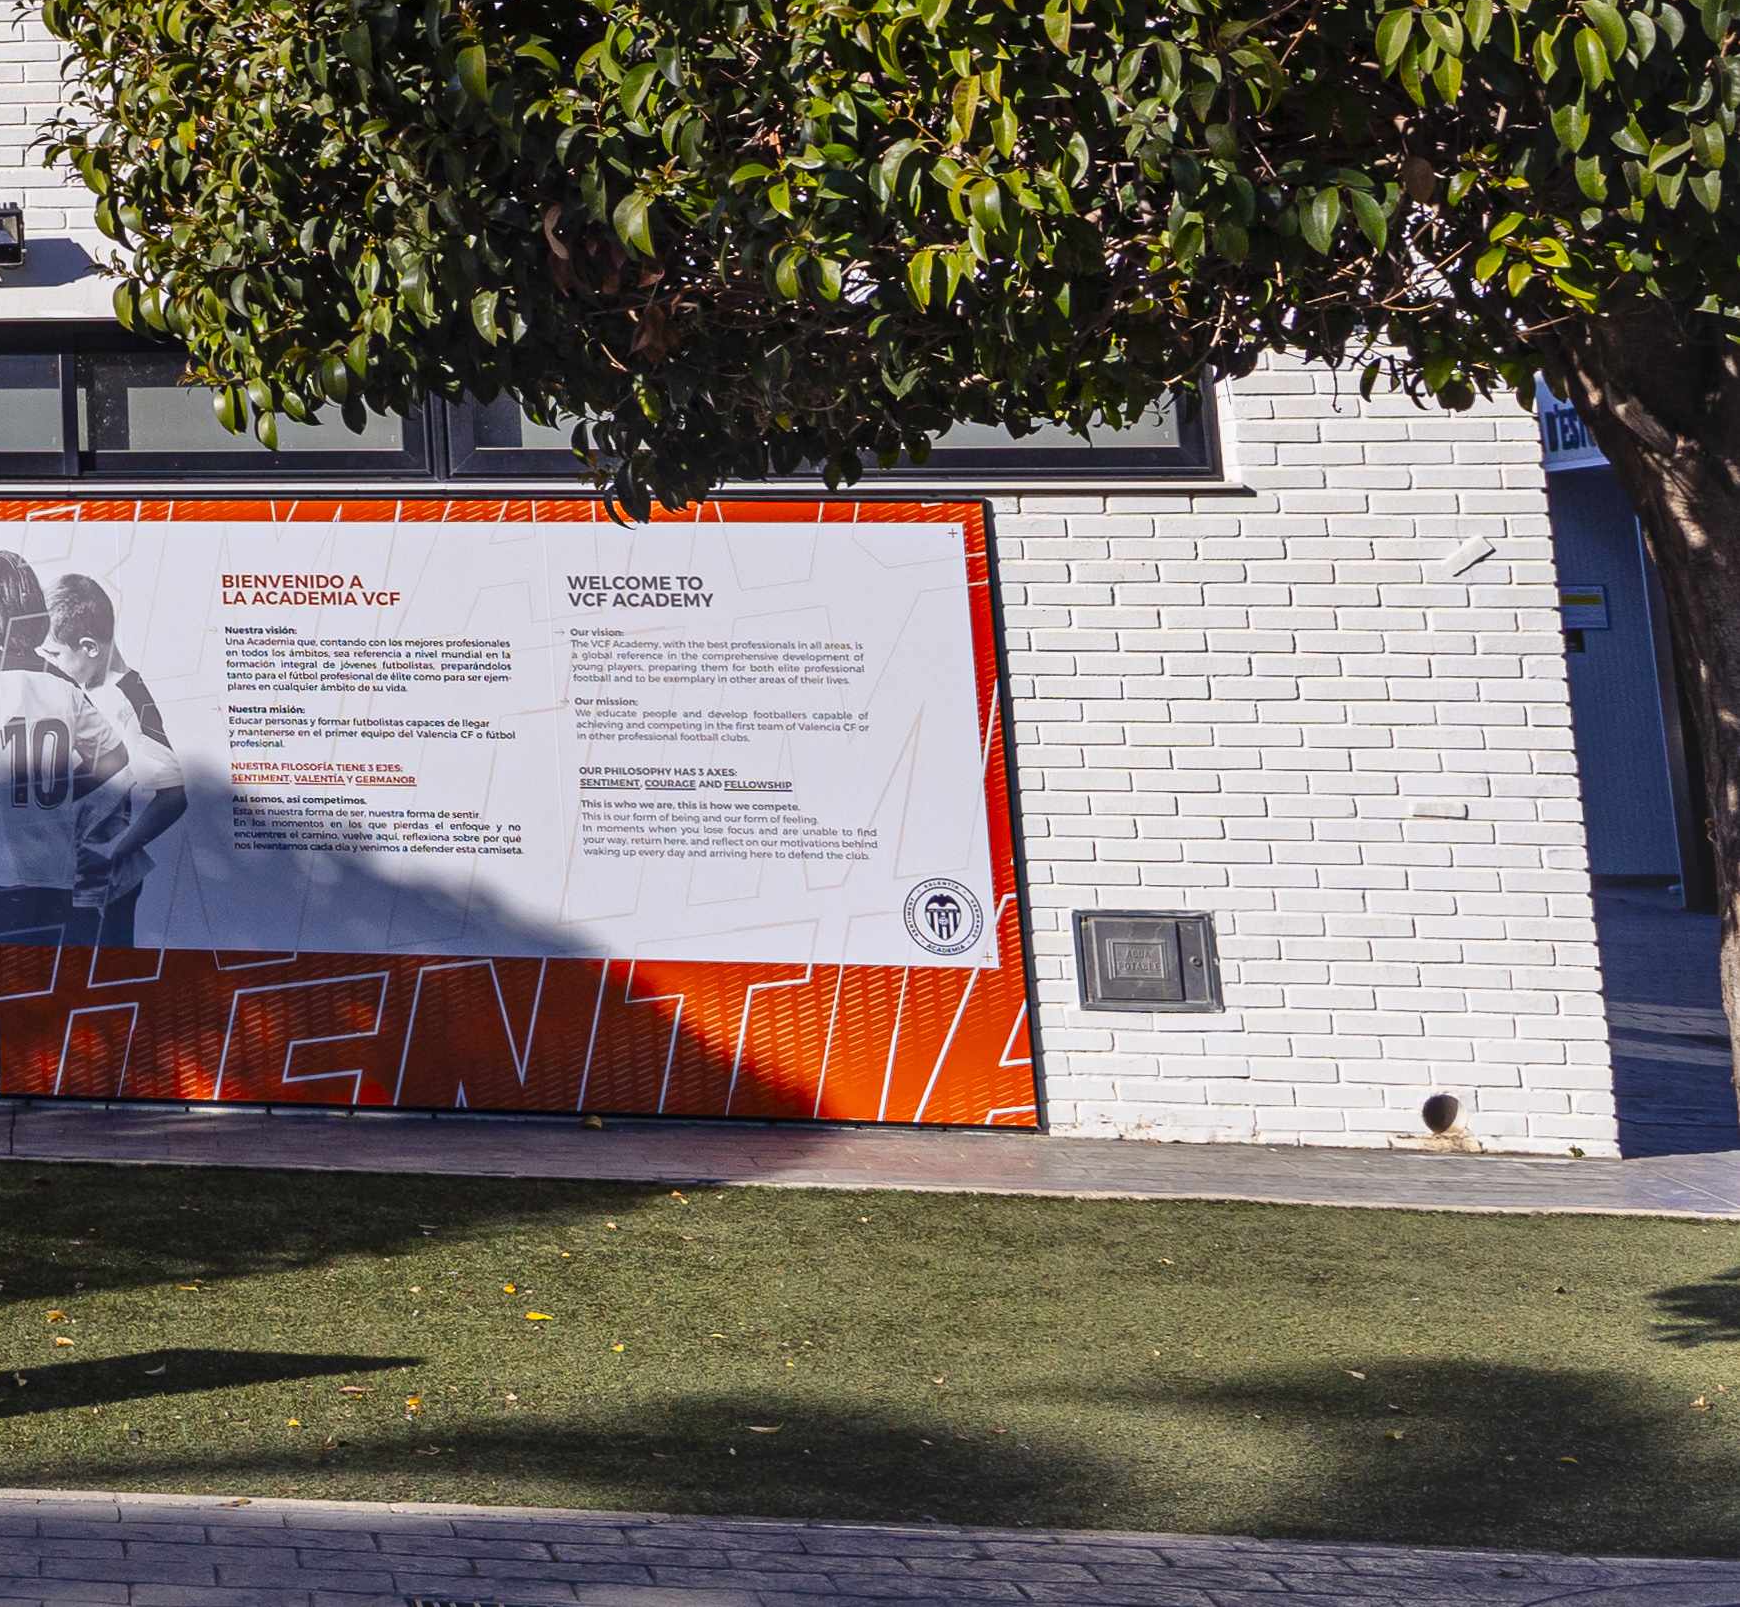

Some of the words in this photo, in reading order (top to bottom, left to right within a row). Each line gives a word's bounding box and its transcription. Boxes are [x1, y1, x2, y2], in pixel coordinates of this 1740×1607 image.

[222, 574, 344, 588] BIENVENIDO
[349, 575, 364, 588] A
[567, 575, 672, 590] WELCOME
[679, 576, 703, 590] TO
[223, 591, 247, 604] LA
[251, 591, 357, 605] ACADEMIA
[363, 592, 400, 605] VCF
[569, 592, 607, 606] VCF
[612, 593, 712, 607] ACADEMY
[225, 626, 264, 634] Nuestra
[265, 626, 297, 634] visión:
[570, 628, 589, 636] Our
[591, 628, 625, 636] vision:
[570, 639, 589, 647] The
[590, 639, 611, 648] VCF
[612, 640, 661, 649] Academy,
[662, 640, 686, 648] with
[688, 640, 705, 648] the
[730, 640, 796, 650] professionals
[798, 641, 808, 649] in
[810, 641, 822, 649] all
[574, 697, 594, 705] Our
[596, 697, 638, 705] mission:
[269, 705, 305, 713] misión:
[0, 717, 71, 810] 10
[231, 762, 279, 770] NUESTRA
[281, 762, 334, 770] FILOSOFÍA
[336, 763, 366, 771] TIENE
[579, 766, 603, 774] OUR
[604, 766, 672, 775] PHILOSOPHY
[698, 768, 705, 776] 3
[706, 768, 738, 776] AXES:
[294, 774, 344, 784] VALENTÍA
[355, 775, 416, 785] GERMANOR
[644, 779, 695, 788] COURAGE
[699, 780, 723, 788] AND
[724, 780, 792, 789] FELLOWSHIP
[233, 794, 247, 802] Así
[286, 795, 300, 803] así
[302, 795, 367, 805] competimos.
[581, 799, 602, 807] This
[614, 800, 637, 808] who
[677, 801, 697, 809] this
[699, 801, 708, 809] is
[752, 803, 800, 812] compete.
[926, 944, 965, 954] ACADEMIA
